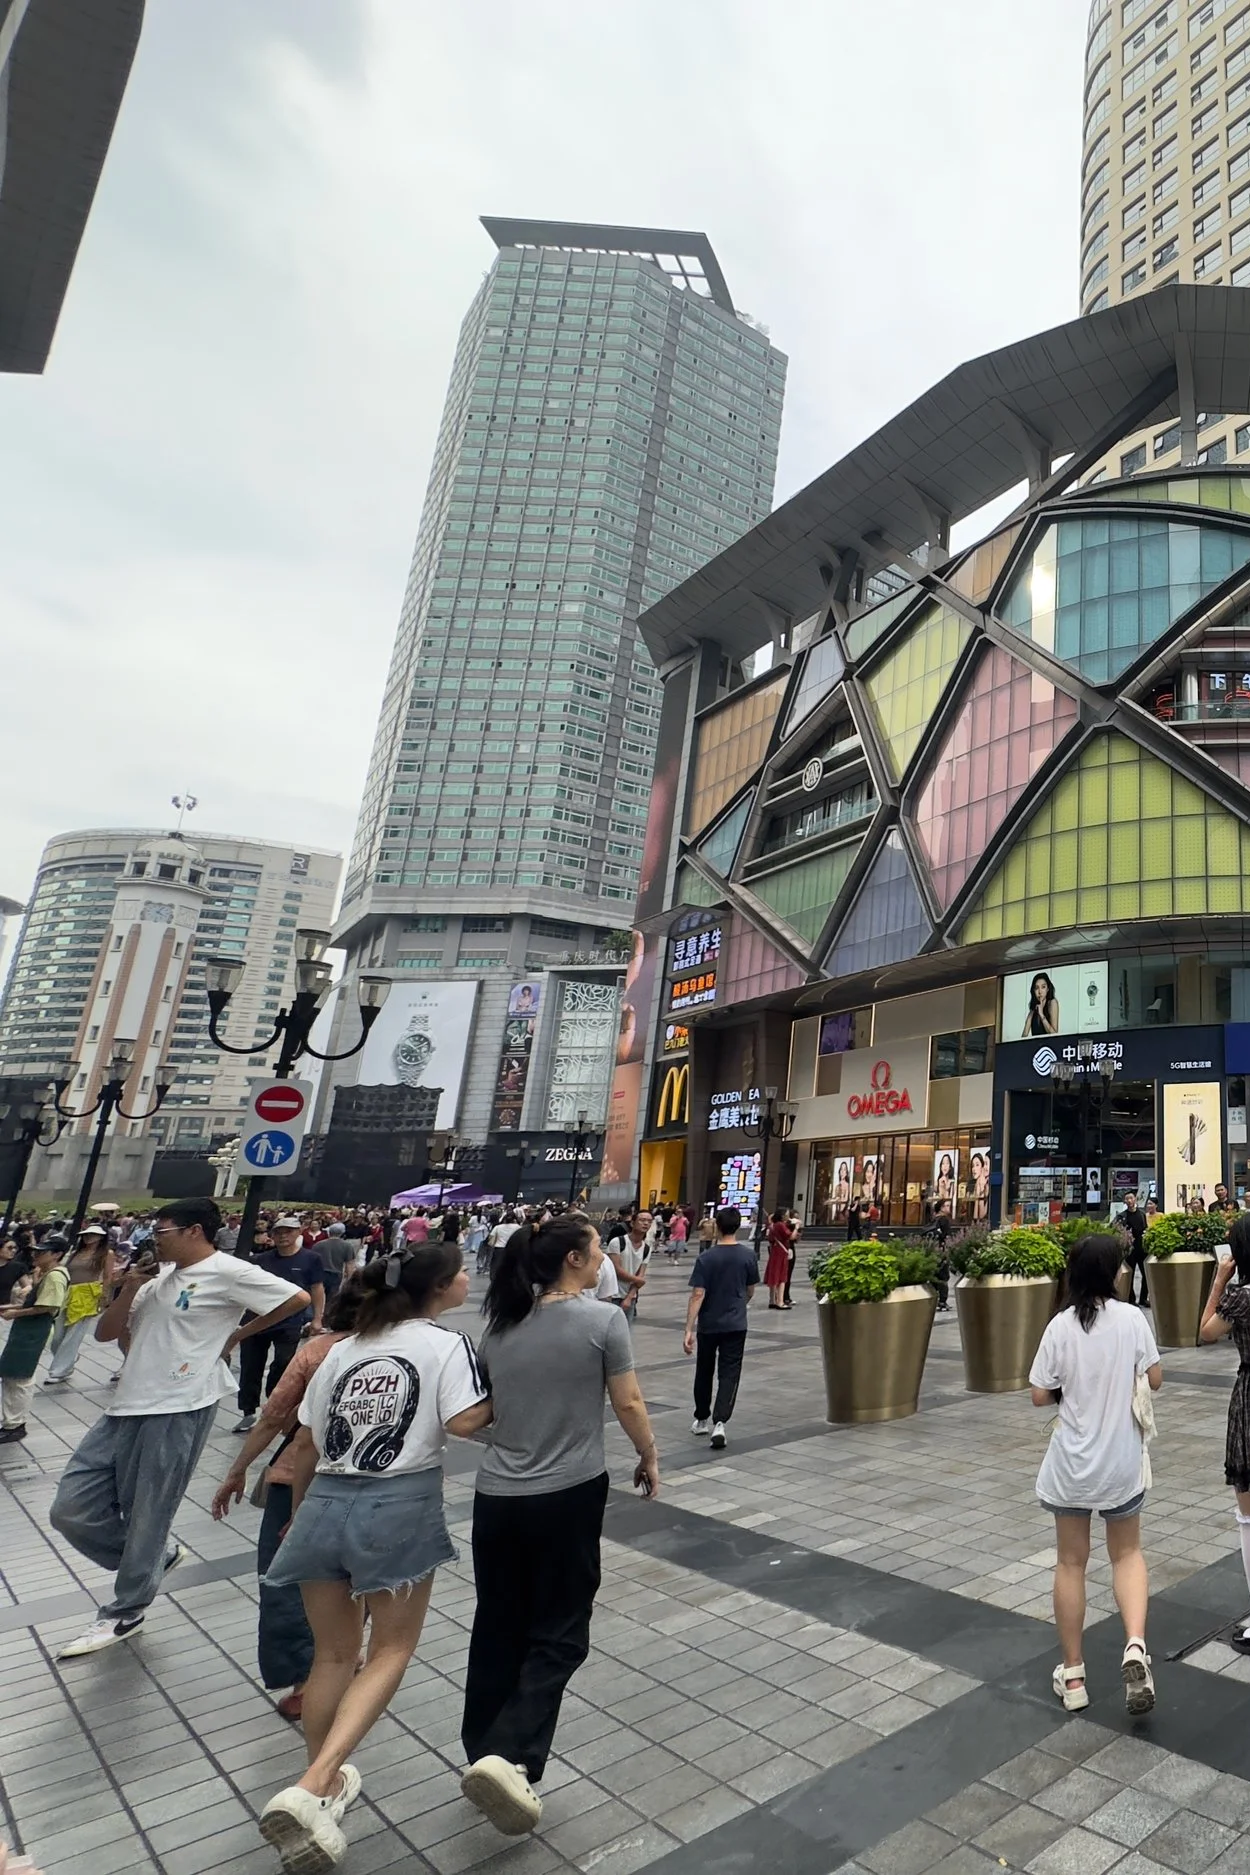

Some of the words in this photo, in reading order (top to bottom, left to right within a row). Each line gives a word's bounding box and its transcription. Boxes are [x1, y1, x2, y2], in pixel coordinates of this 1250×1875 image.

[711, 1090, 742, 1106] GOLDEN
[847, 1087, 912, 1120] OMEGA
[350, 1374, 400, 1396] PXZH
[338, 1398, 375, 1412] EFGABC
[351, 1409, 374, 1427] ONE
